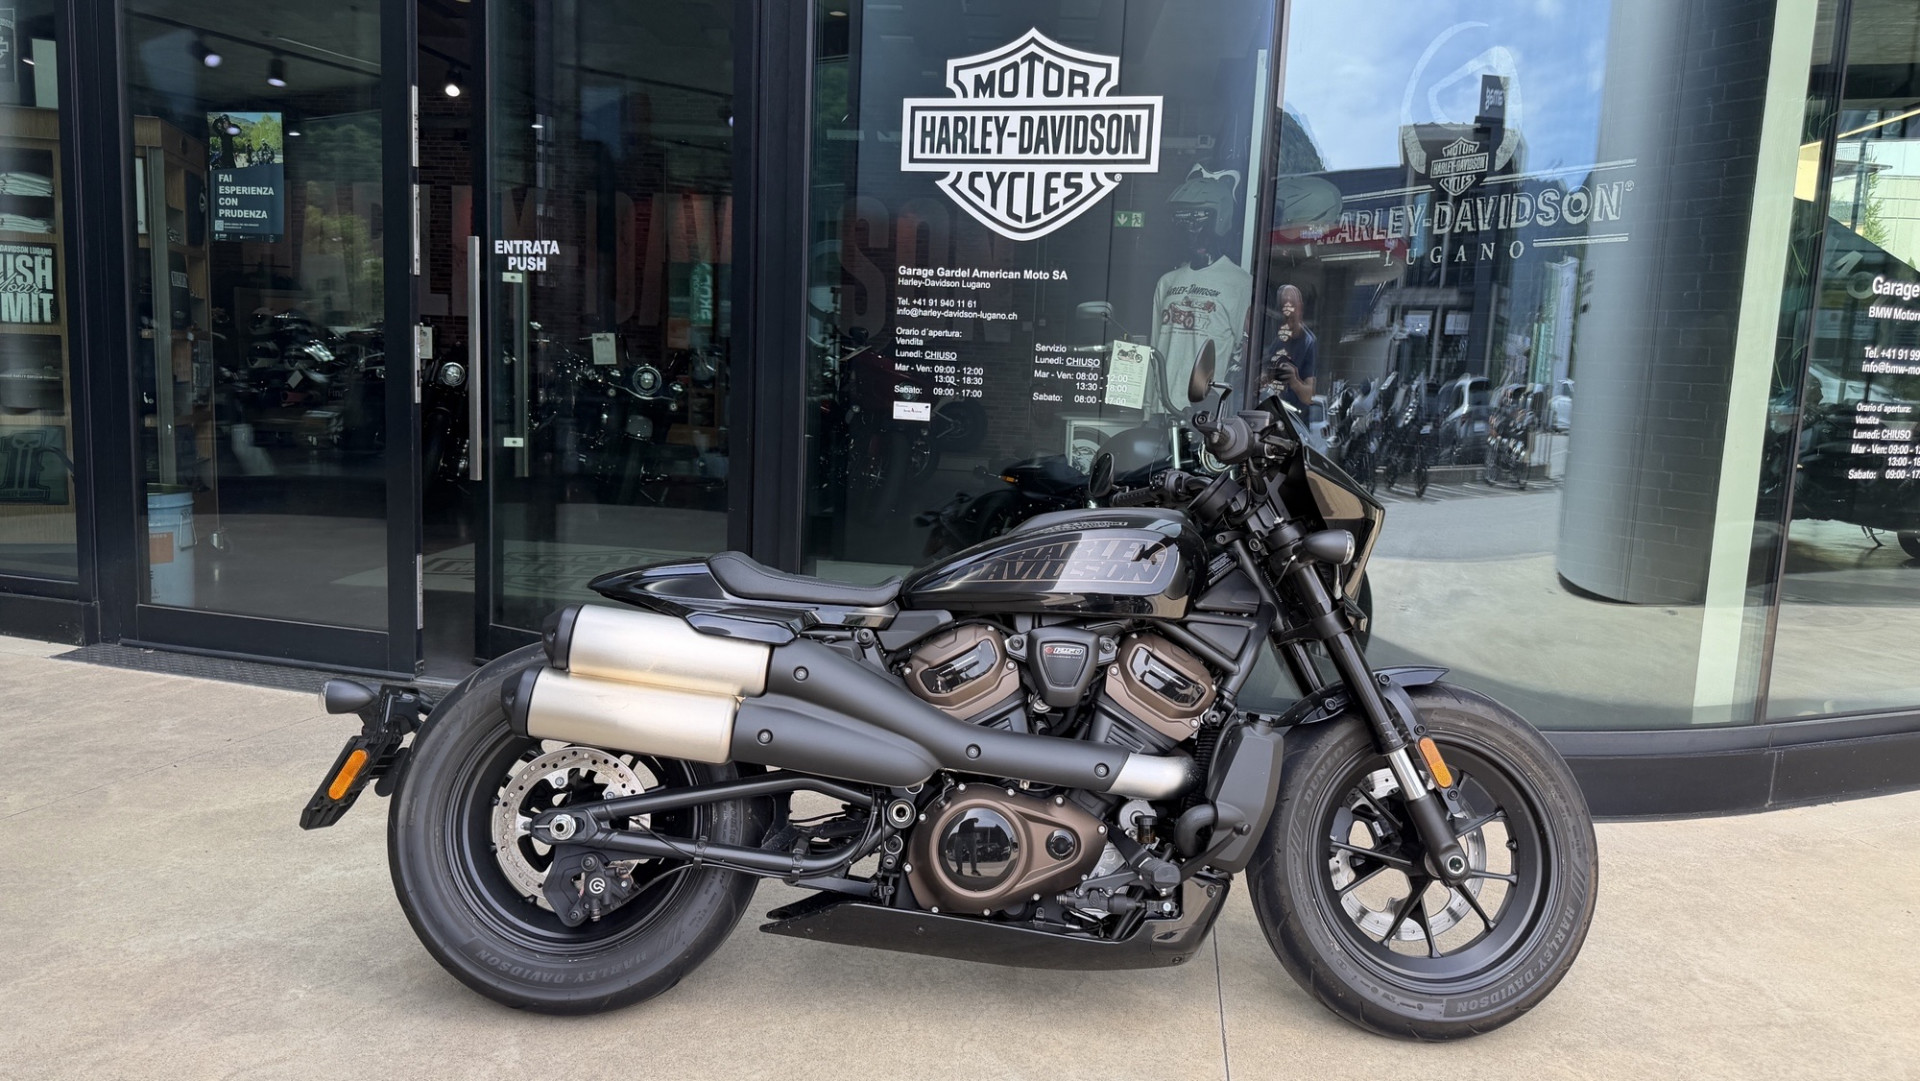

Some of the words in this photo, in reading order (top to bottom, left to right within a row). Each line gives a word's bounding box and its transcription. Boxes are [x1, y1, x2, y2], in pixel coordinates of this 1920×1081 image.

[973, 51, 1090, 98] MOTOR
[920, 113, 1141, 155] HARLEY-DAVIDSON
[1446, 142, 1474, 156] MOTOR
[1433, 156, 1486, 175] HARLEY-DAVIDSON
[218, 174, 232, 182] FAI
[1444, 175, 1472, 192] CYCLES
[218, 186, 274, 195] ESPERIENZA
[218, 198, 238, 206] CON
[968, 171, 1083, 224] CYCLES
[218, 209, 268, 219] PRUDENZA
[1317, 181, 1624, 246] ARLEY-DAVIDSON
[495, 240, 560, 254] ENTRATA
[1384, 241, 1524, 267] LUGANO
[508, 256, 547, 271] PUSH
[898, 266, 934, 278] Garage
[936, 267, 970, 278] Gardel
[972, 268, 1021, 279] American
[1024, 270, 1050, 280] Moto
[1052, 270, 1068, 280] SA
[898, 278, 960, 288] Harley-Davidson
[962, 280, 991, 290] Lugano
[1872, 276, 1920, 300] Garage
[898, 297, 910, 306] Tel.
[912, 298, 926, 306] +41
[897, 308, 1018, 321] info@harley-davidson-lugano.ch
[1868, 306, 1893, 319] BMW
[896, 327, 919, 336] Orario
[895, 337, 923, 346] Vendita
[1035, 343, 1067, 352] Servizio
[1864, 346, 1879, 358] Tel.
[1881, 348, 1896, 359] +41
[1898, 349, 1908, 360] 91
[924, 350, 957, 360] CHIUSO
[1066, 357, 1100, 368] CHIUSO
[895, 363, 909, 371] Mar
[916, 364, 932, 373] Ven:
[934, 365, 955, 374] 09:00
[963, 367, 984, 375] 12:00
[962, 377, 983, 385] 18:30
[1076, 372, 1098, 381] 08:00
[894, 385, 923, 394] Sabato:
[933, 388, 954, 396] 09:00
[962, 389, 982, 398] 17:00
[1076, 382, 1097, 390] 13:30
[1033, 392, 1063, 402] Sabato:
[1074, 395, 1096, 404] 08:00
[1856, 403, 1876, 412] Orario
[1856, 416, 1879, 424] Vendita
[1881, 430, 1911, 441] CHIUSO
[1851, 444, 1866, 454] Mar
[1872, 445, 1888, 454] Ven:
[1888, 445, 1908, 454] 09:00
[1888, 457, 1907, 466] 13:00
[1848, 469, 1877, 479] Sabato:
[1885, 470, 1905, 479] 09:00
